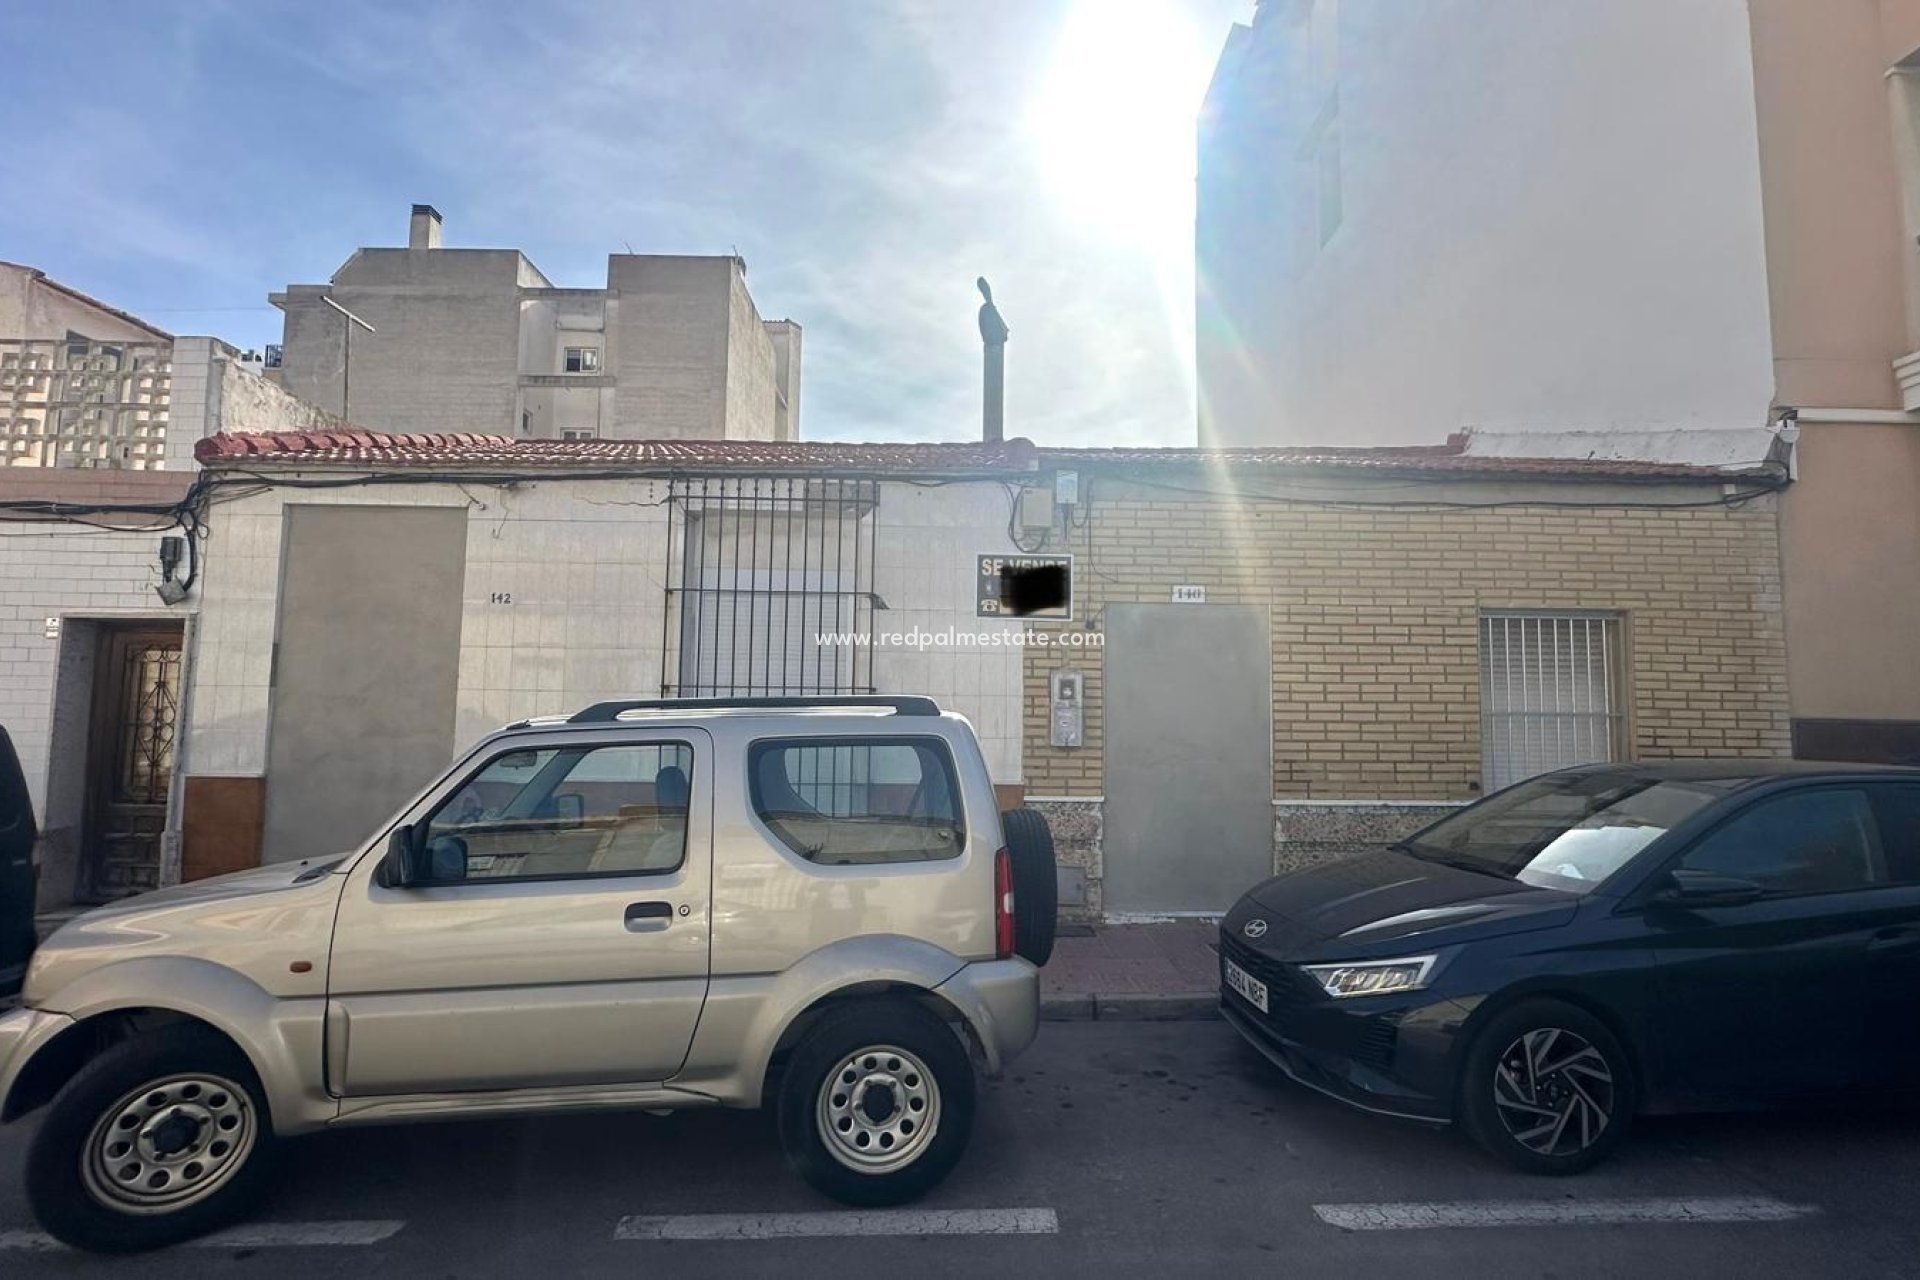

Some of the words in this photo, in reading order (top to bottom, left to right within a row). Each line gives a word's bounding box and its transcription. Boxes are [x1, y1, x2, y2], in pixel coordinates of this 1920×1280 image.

[982, 559, 1004, 576] SE
[492, 593, 511, 604] 142
[1177, 587, 1202, 600] 140
